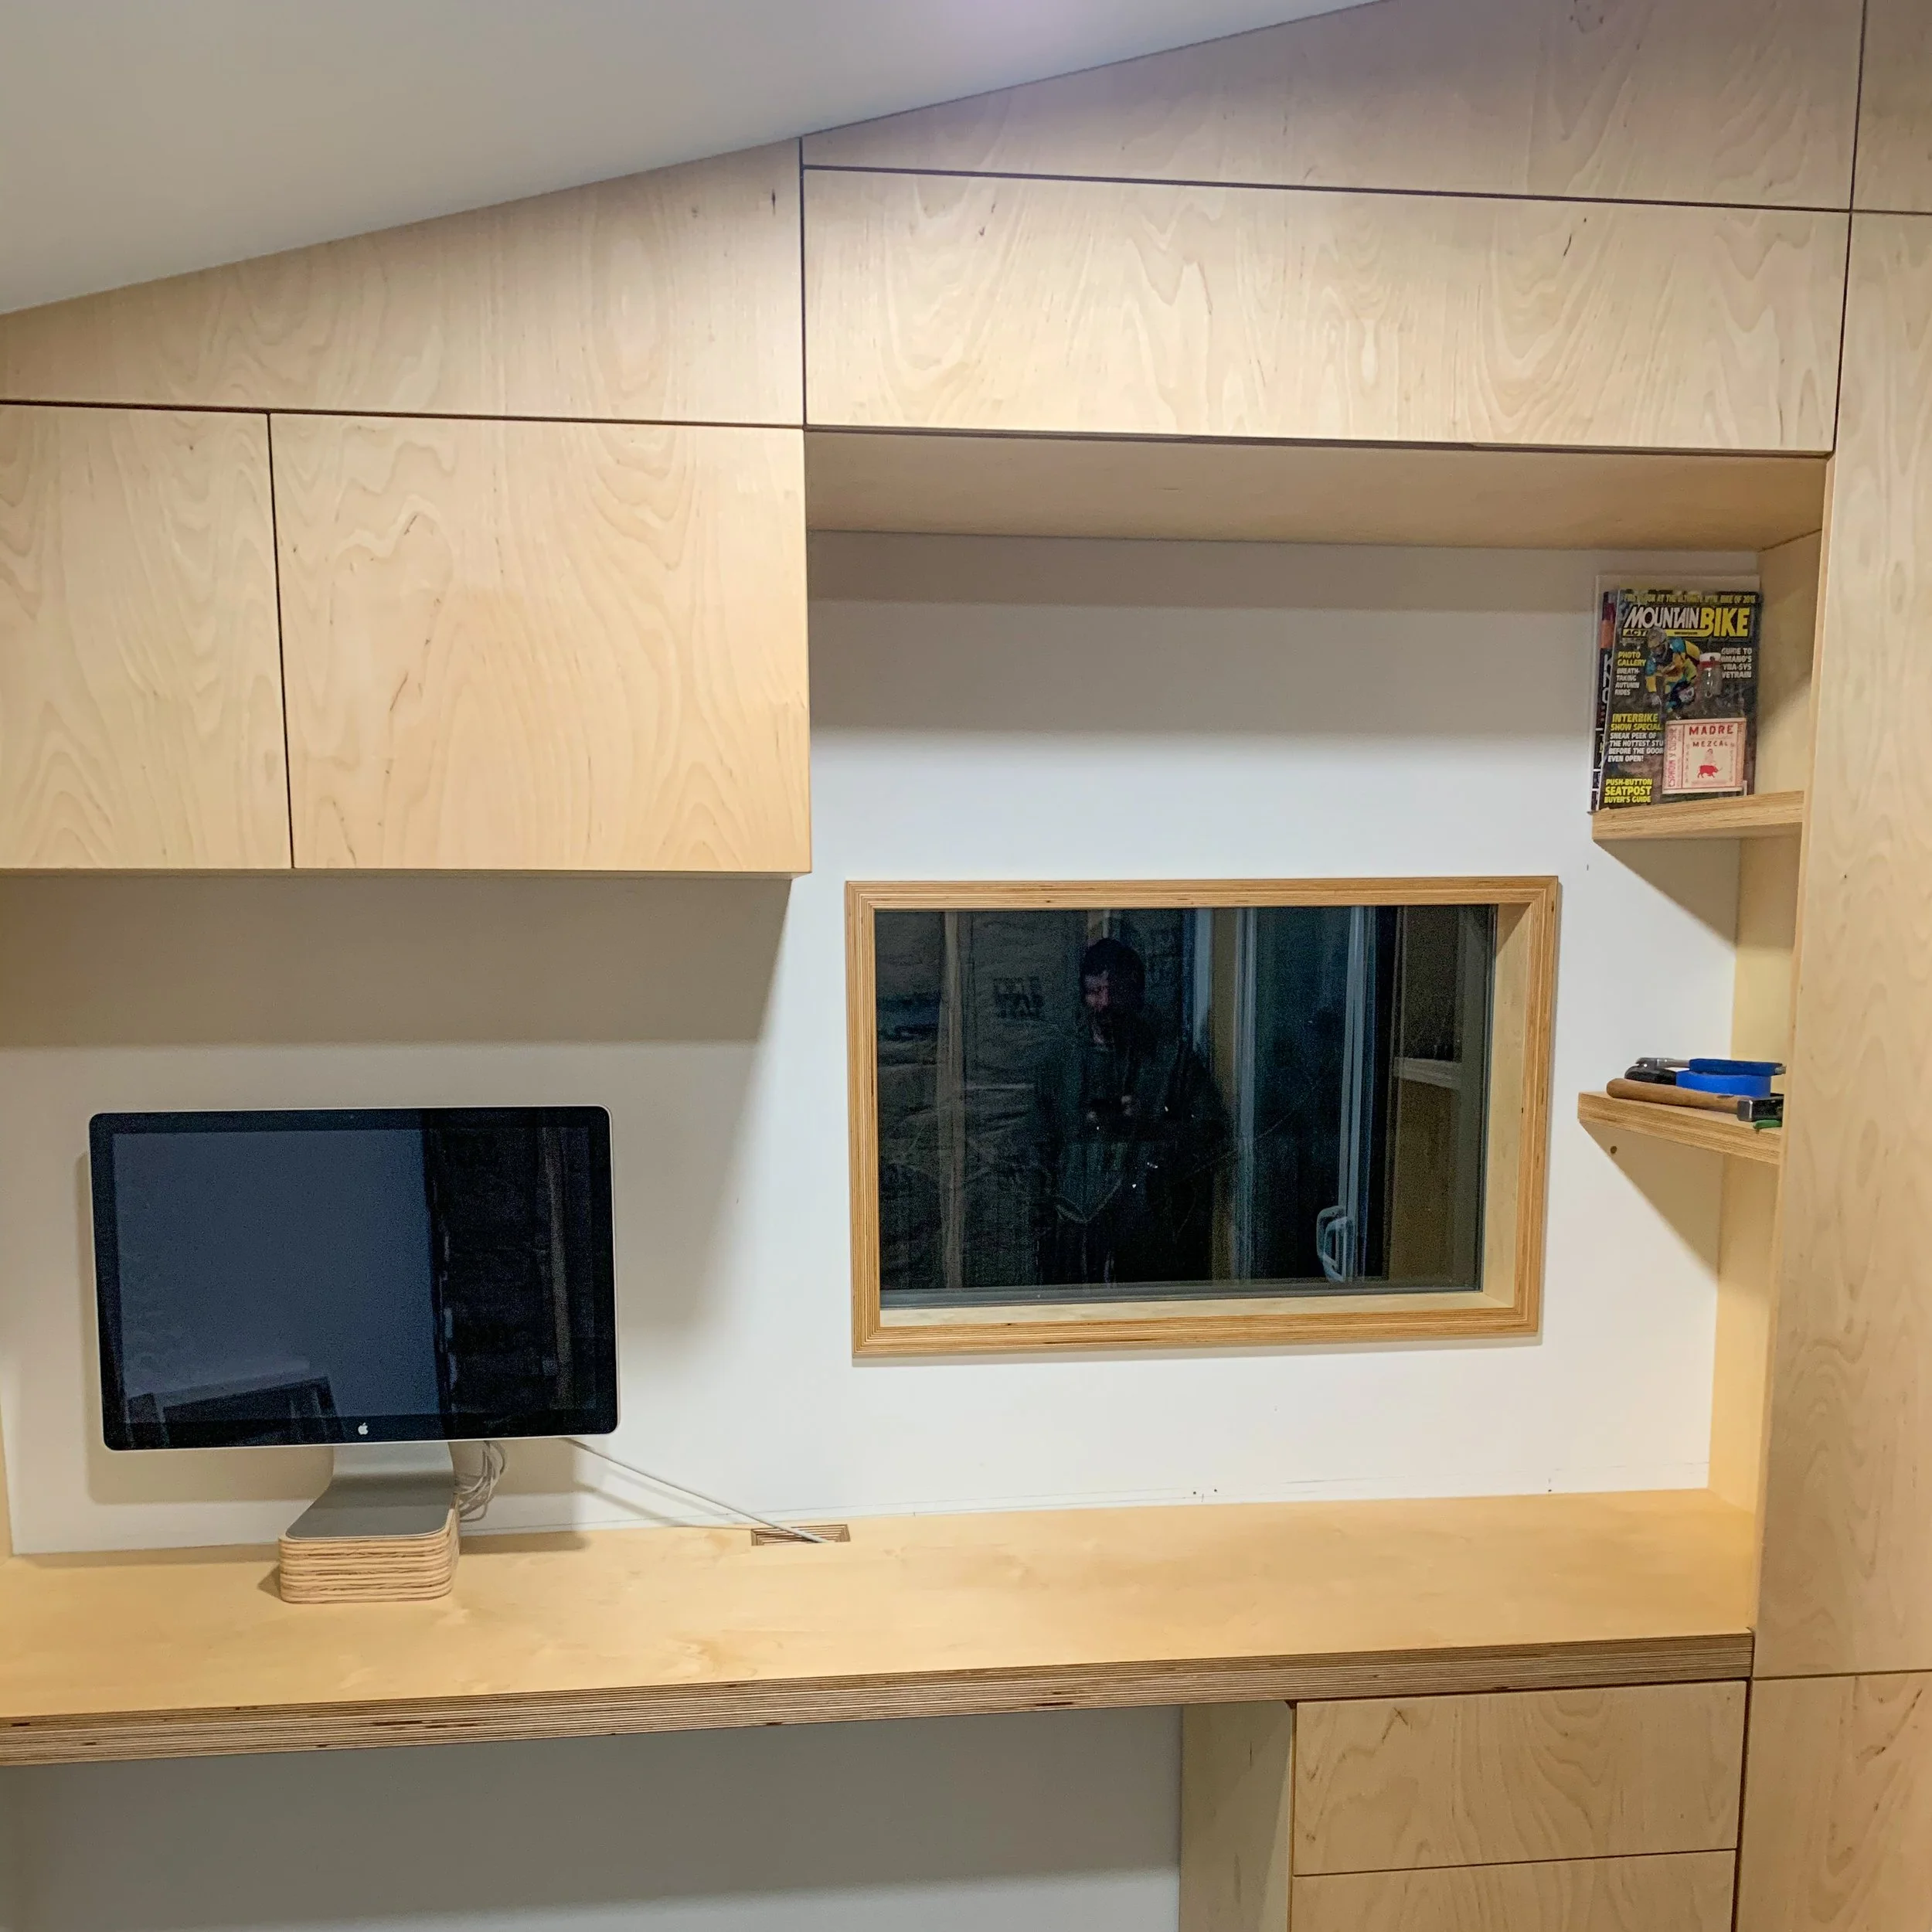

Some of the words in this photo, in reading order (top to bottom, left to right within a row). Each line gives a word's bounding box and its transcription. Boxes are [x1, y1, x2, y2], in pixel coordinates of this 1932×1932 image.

[1624, 606, 1699, 629] MOUNTAIN
[1699, 607, 1750, 638] BIKE
[1617, 651, 1641, 659] PHOTO
[1721, 647, 1741, 655] GUIDE
[1722, 670, 1752, 679] VETRAIN
[1612, 713, 1658, 723] INTERBIKE
[1633, 723, 1662, 731] SPECIAL
[1689, 725, 1734, 736] MADRE
[1607, 754, 1624, 763] EVEN
[1604, 786, 1652, 796] SEATPOST
